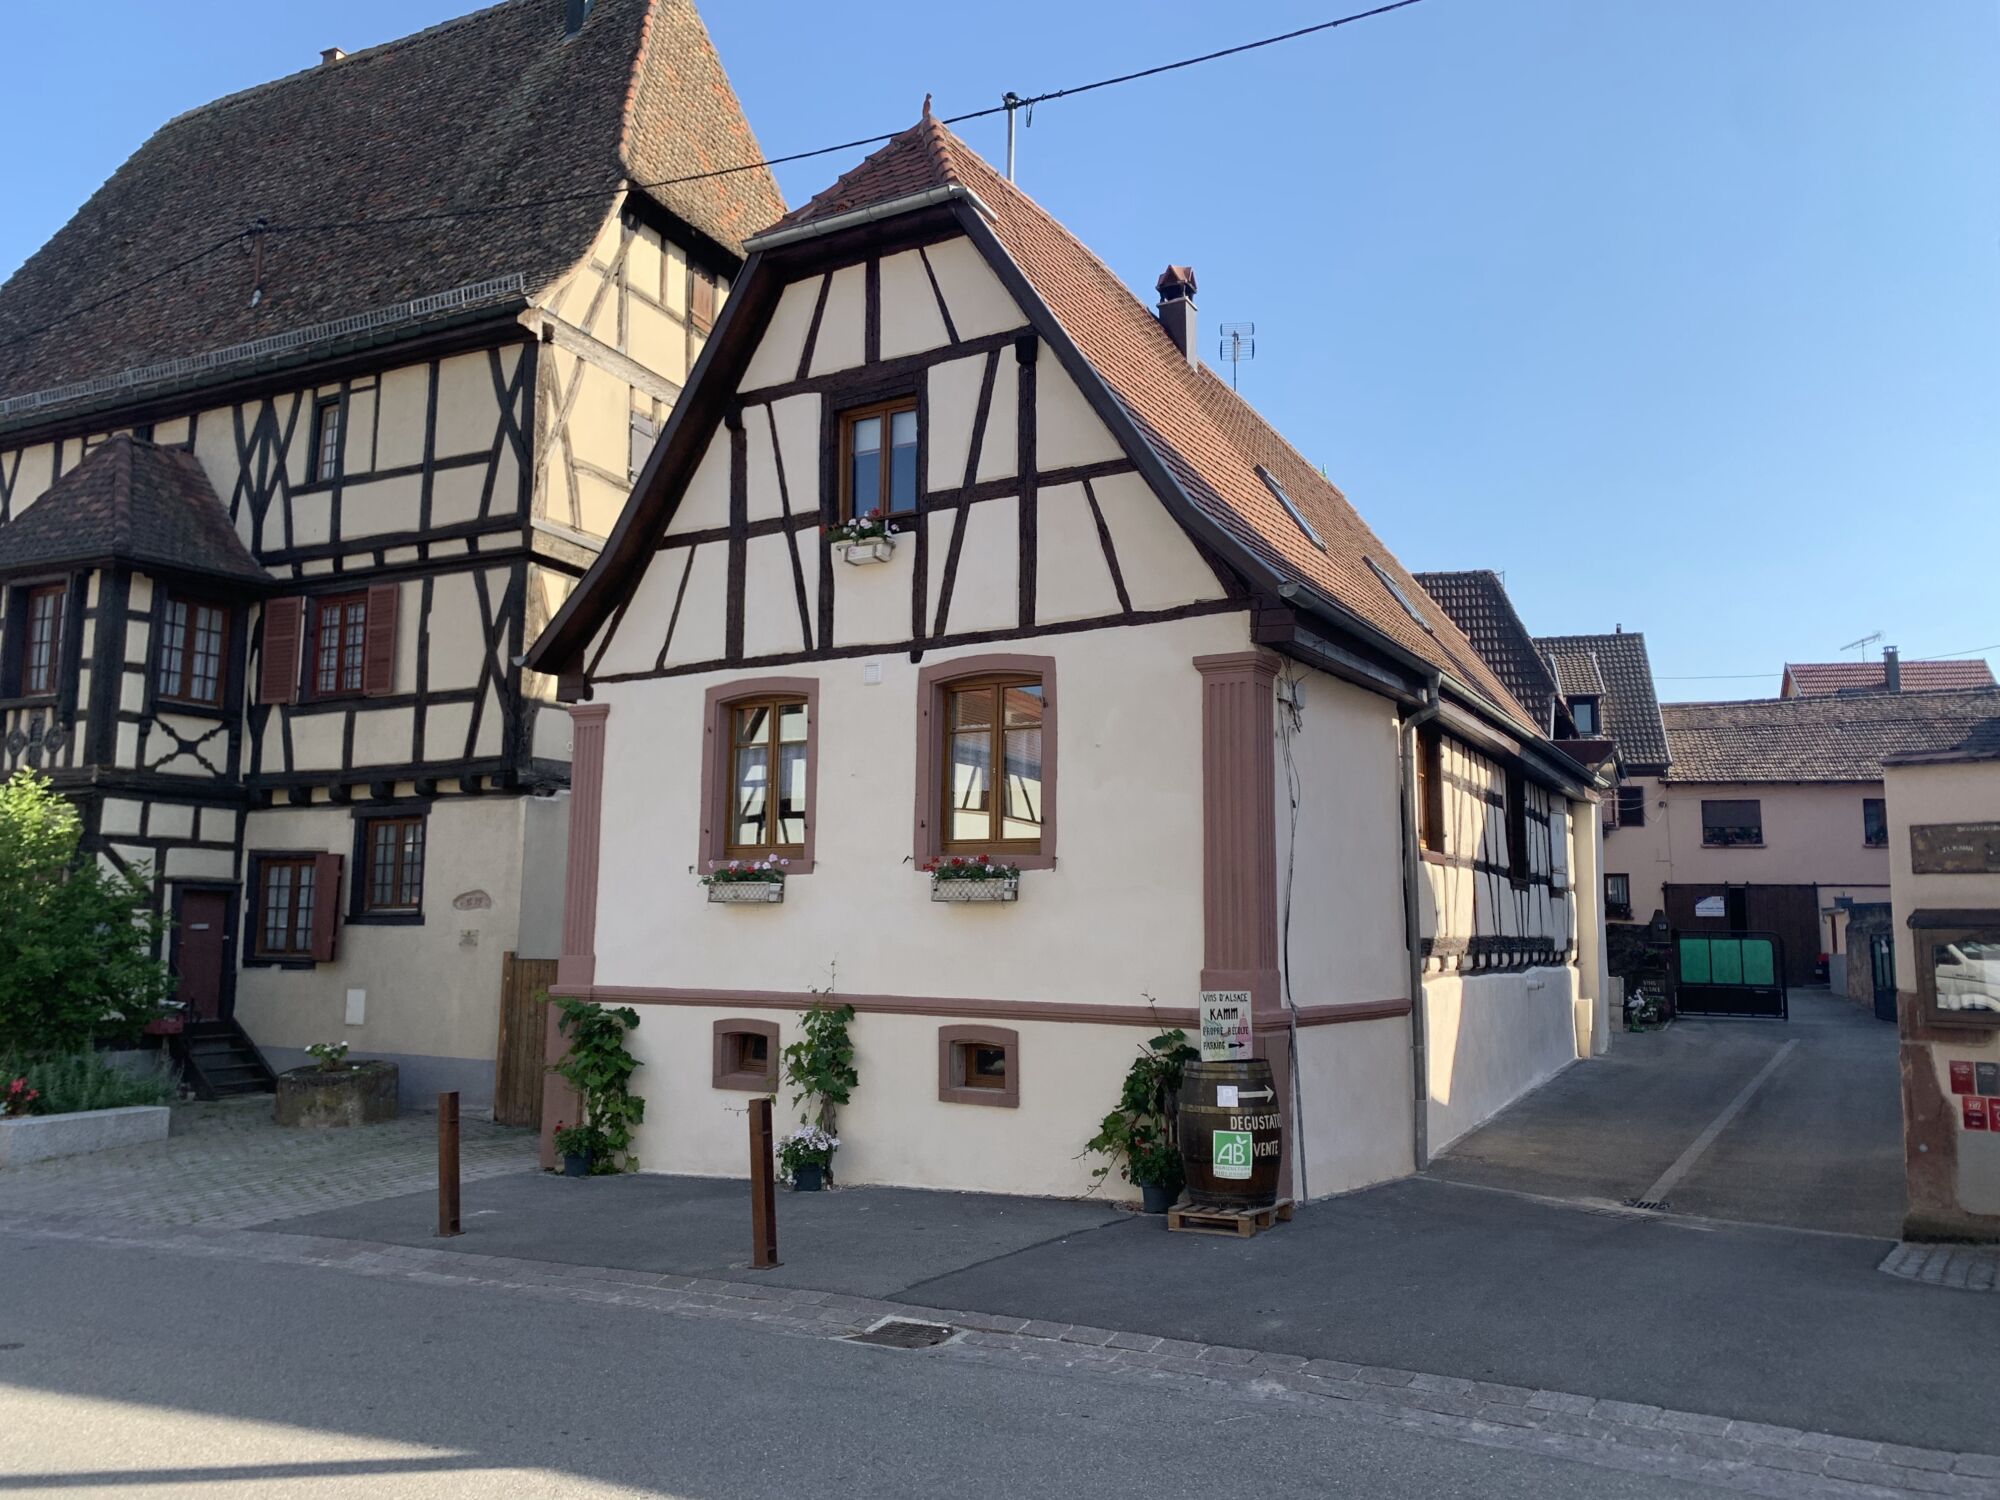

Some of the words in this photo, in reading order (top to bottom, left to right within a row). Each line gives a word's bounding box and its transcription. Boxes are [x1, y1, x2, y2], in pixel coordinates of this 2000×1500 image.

[1209, 1007, 1239, 1021] KAMM
[1217, 1142, 1246, 1165] AB
[1253, 1140, 1279, 1157] VENTE
